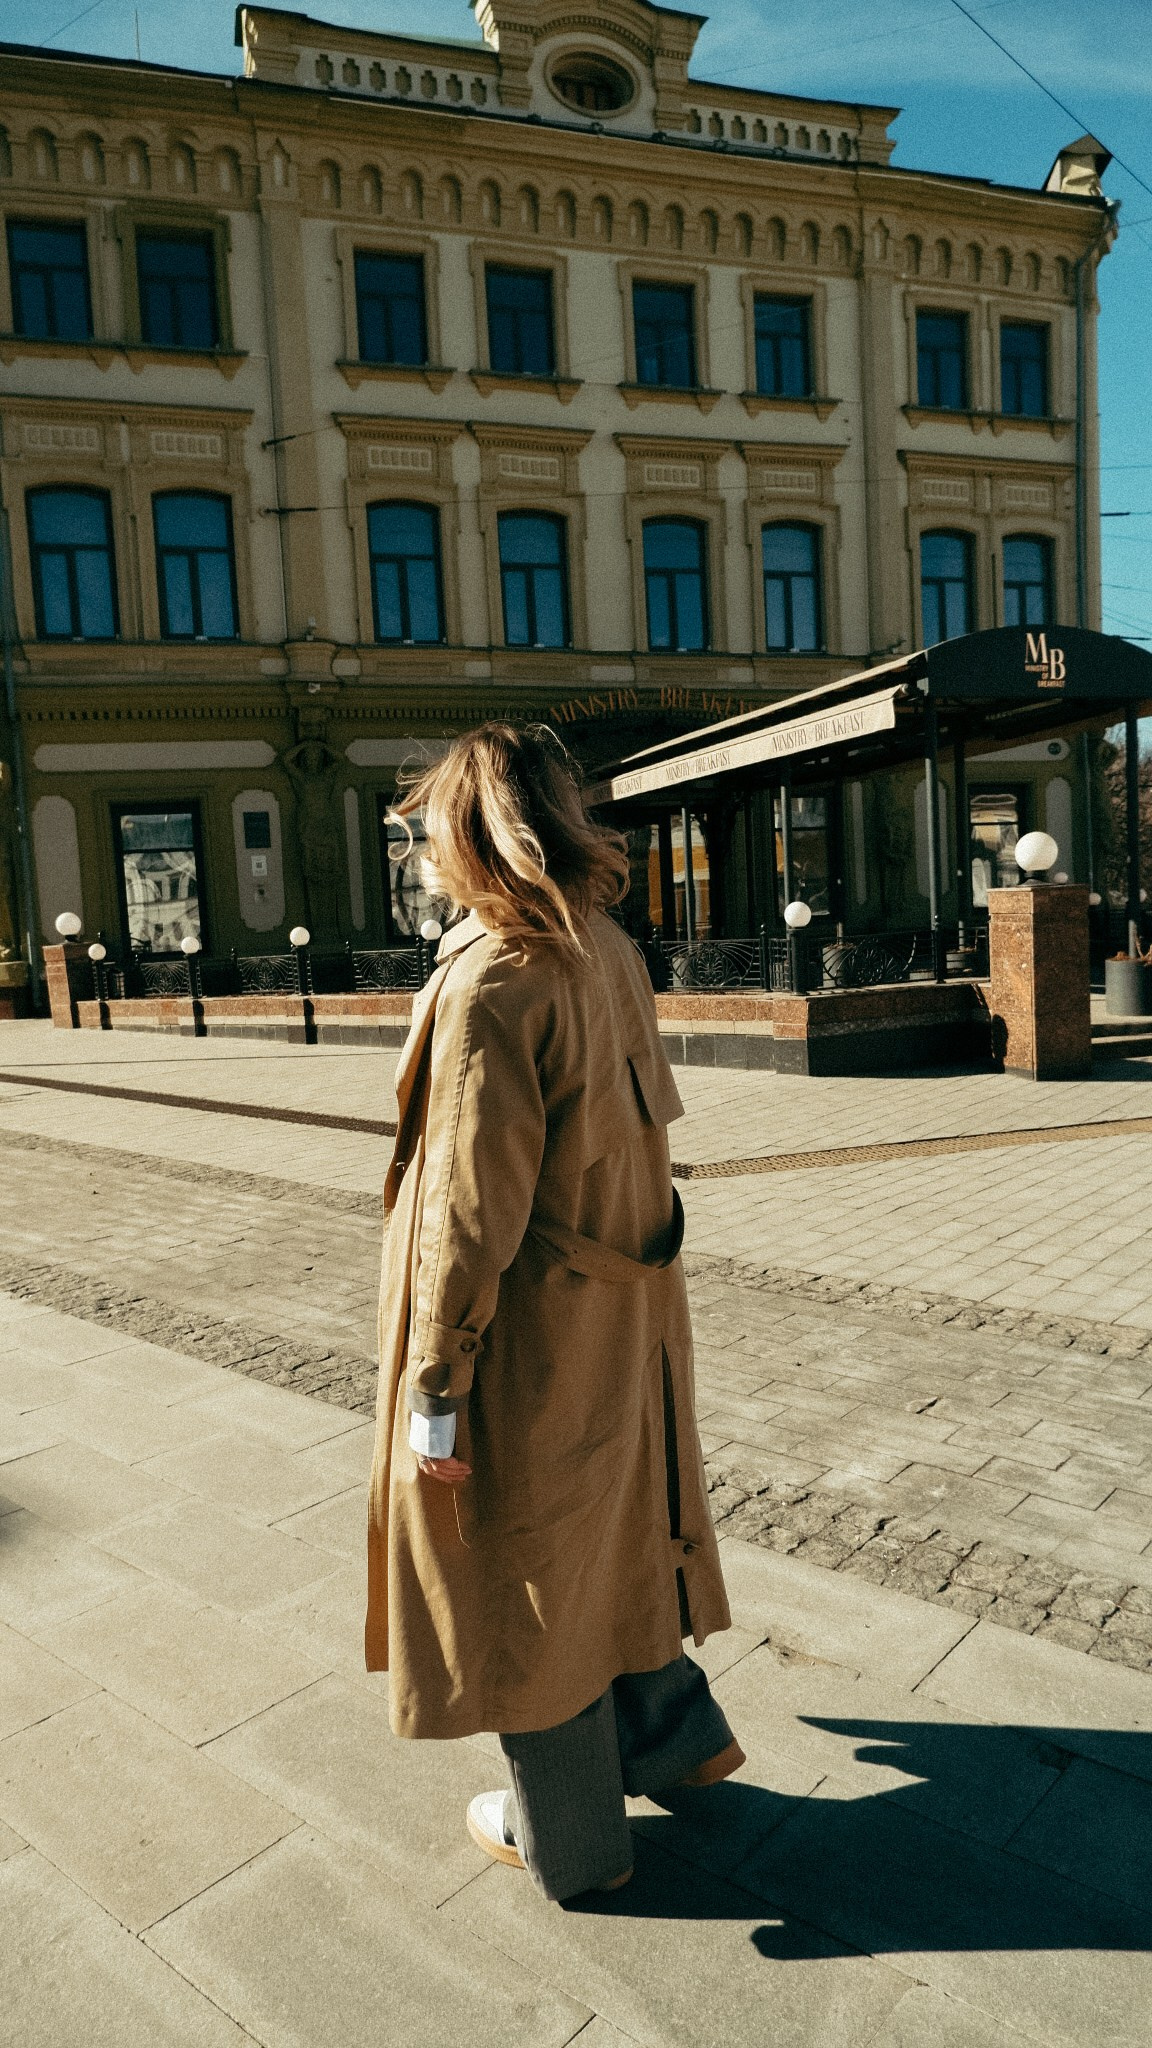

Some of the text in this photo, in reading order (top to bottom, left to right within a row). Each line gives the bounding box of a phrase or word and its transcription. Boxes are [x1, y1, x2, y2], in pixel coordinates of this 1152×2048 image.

[548, 688, 638, 723] MINISTRY
[772, 728, 807, 753] MINISTRY
[814, 711, 865, 741] BREAKFAST
[665, 761, 690, 781] MINISTRY
[695, 750, 731, 774] BREAKFAST
[615, 776, 642, 796] BREAKFAST
